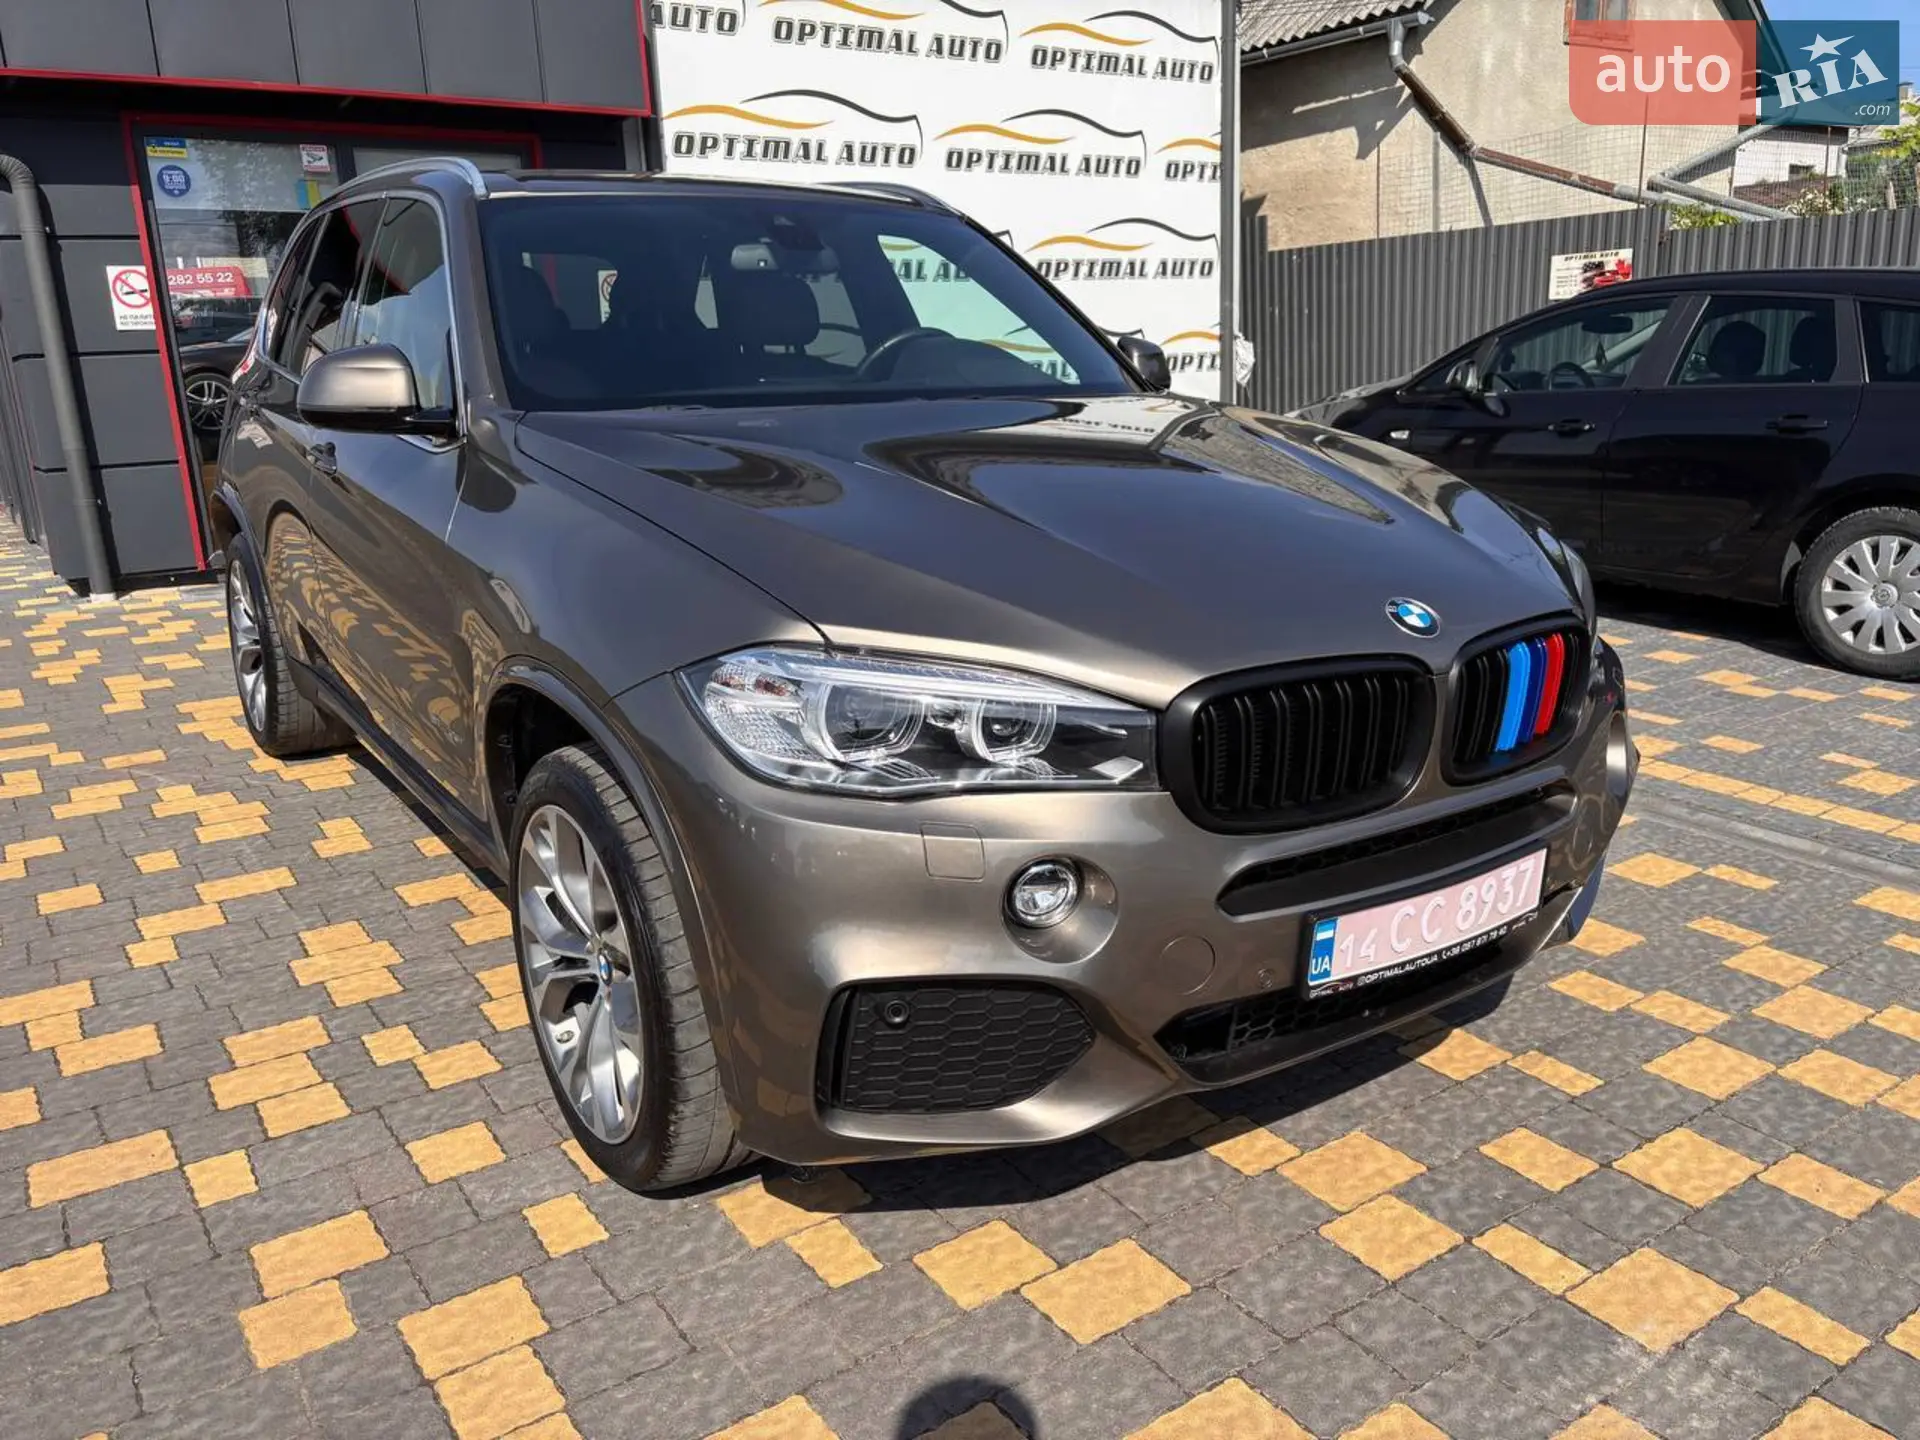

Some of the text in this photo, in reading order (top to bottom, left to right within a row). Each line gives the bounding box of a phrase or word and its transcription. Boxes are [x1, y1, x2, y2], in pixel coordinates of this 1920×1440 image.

[650, 1, 739, 36] AUTO
[773, 16, 1004, 63] OPTIMAL AUTO
[1031, 44, 1214, 84] OPTIMAL AUTO
[672, 131, 918, 168] OPTIMAL AUTO
[945, 148, 1142, 178] OPTIMAL AUTO
[167, 272, 234, 286] 282 55 22
[1152, 258, 1214, 280] AUTO
[1340, 858, 1535, 968] 14 CC 8937
[1311, 955, 1331, 975] UA
